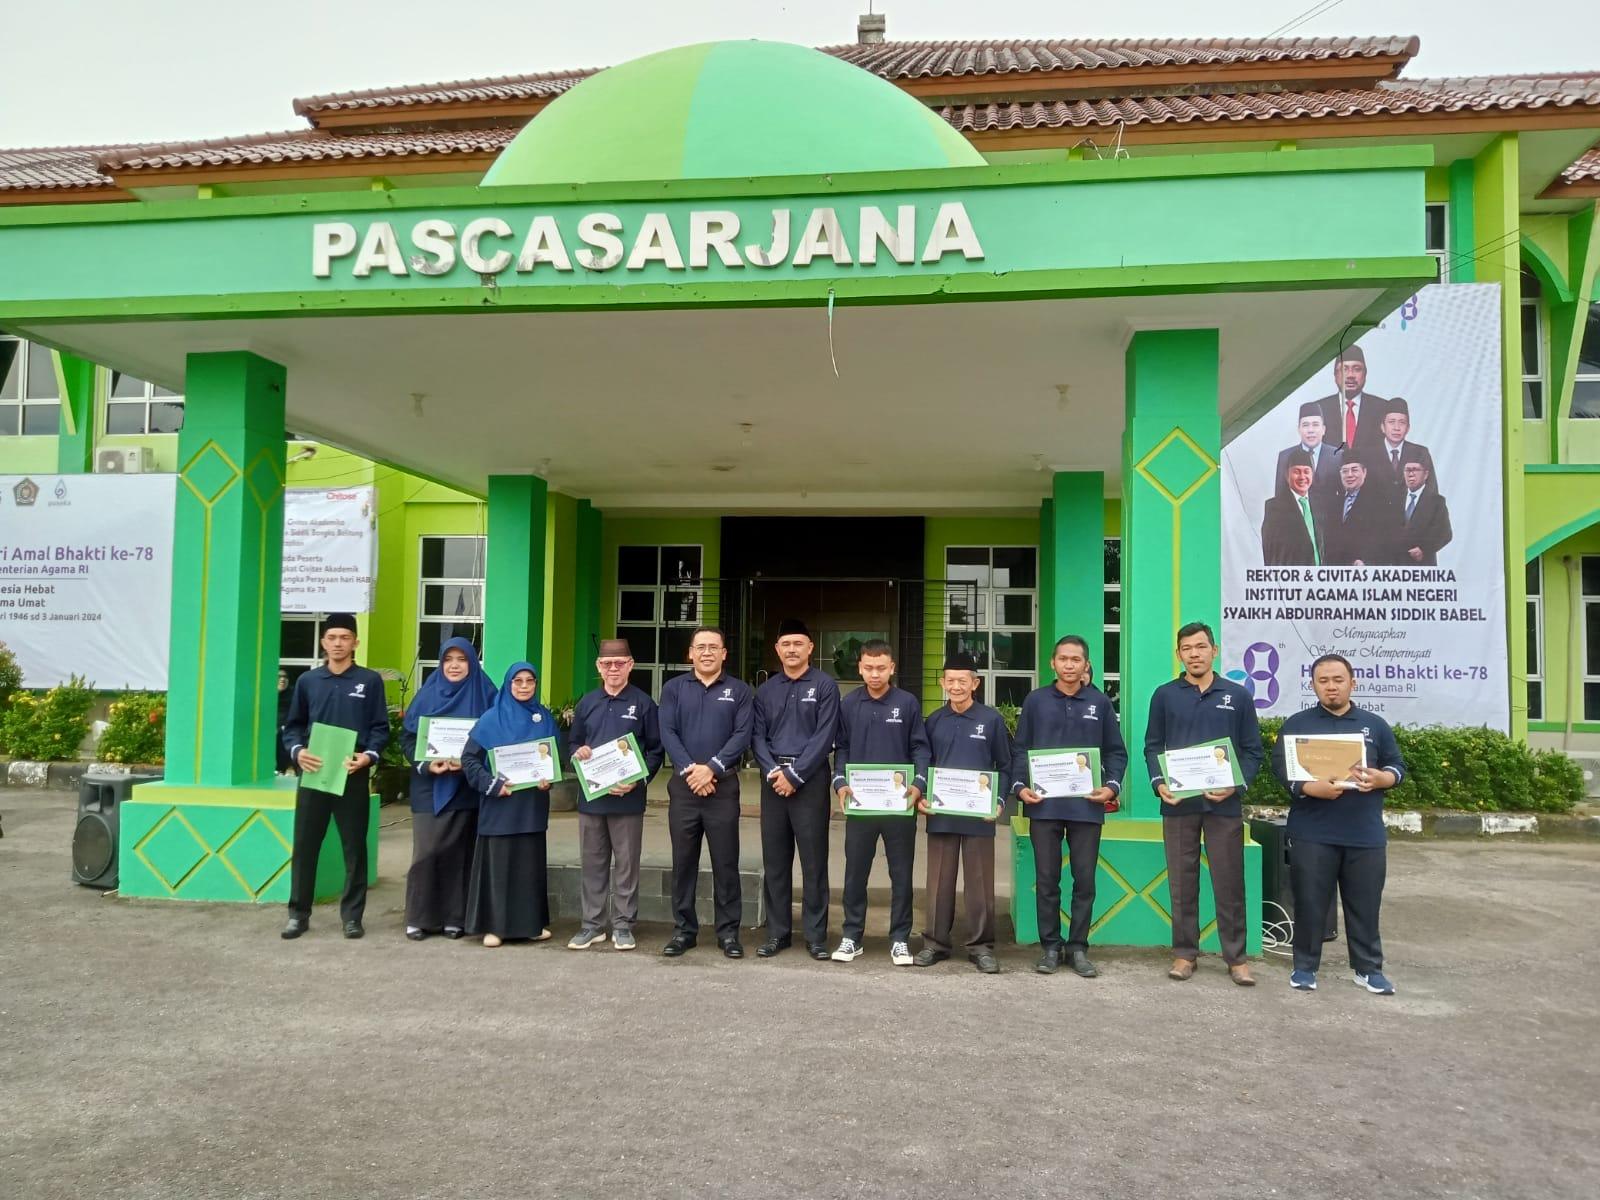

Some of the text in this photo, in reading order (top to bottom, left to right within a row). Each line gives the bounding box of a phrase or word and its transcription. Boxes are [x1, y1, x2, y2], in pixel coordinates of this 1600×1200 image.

[311, 201, 986, 278] PASCASARJANA
[11, 546, 50, 561] Amal
[55, 546, 106, 561] Bhakti
[110, 546, 154, 561] ke-78
[41, 565, 76, 576] Agama
[78, 565, 89, 574] RI
[1246, 569, 1457, 582] REKTOR & CIVITAS AKADEMIKA
[24, 584, 55, 594] Hebat
[1245, 588, 1458, 602] INSTITUT AGAMA ISLAM NEGERI
[18, 598, 46, 608] Umat
[9, 612, 29, 620] 1946
[42, 612, 48, 621] 3
[49, 612, 80, 621] Januari
[81, 612, 103, 621] 2024
[1223, 607, 1487, 621] SYAIKH ABDURRAHMAN SIDDIK BABEL
[1332, 625, 1407, 643] Mengucapkan
[1360, 644, 1432, 663] Memperingati
[1385, 664, 1438, 680] Bhakti
[1443, 664, 1489, 680] ke-78
[1367, 683, 1404, 694] Agama
[1406, 683, 1416, 693] RI
